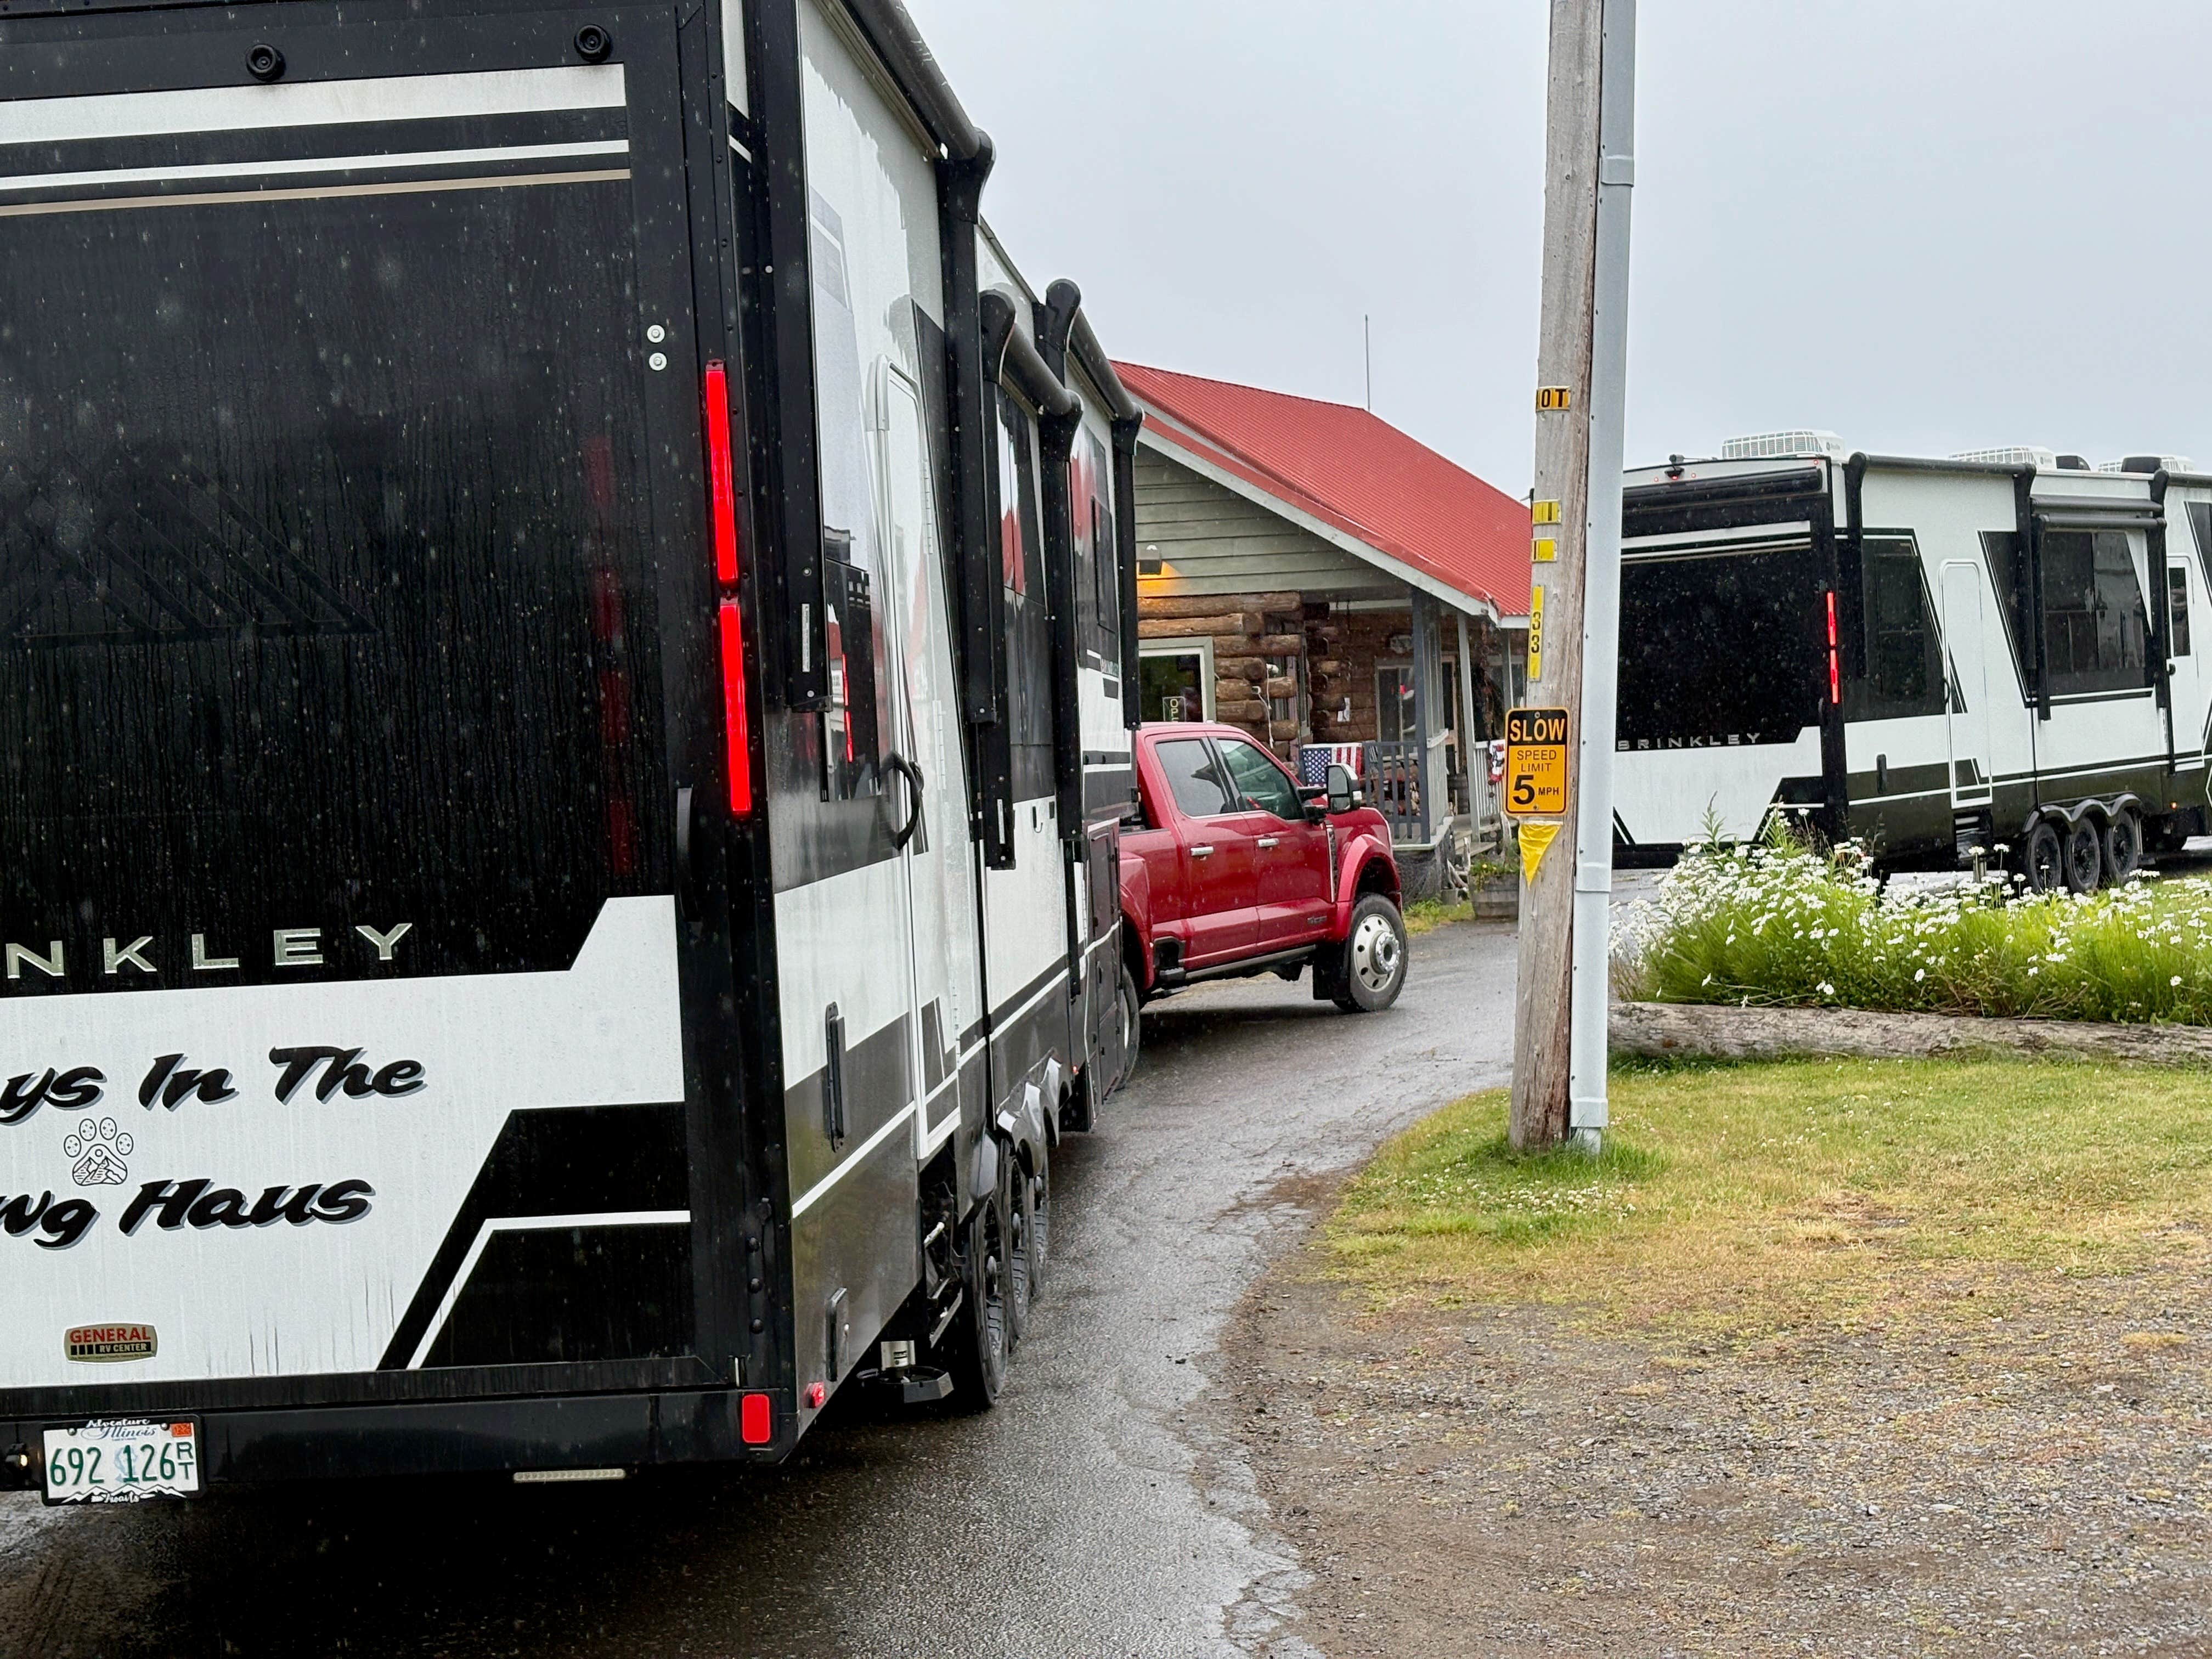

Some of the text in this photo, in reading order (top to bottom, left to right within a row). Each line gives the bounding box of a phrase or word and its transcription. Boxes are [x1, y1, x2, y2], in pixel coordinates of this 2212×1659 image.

[1536, 388, 1567, 408] OT
[1531, 611, 1541, 654] 33
[1510, 718, 1565, 742] SLOW
[1618, 732, 1760, 751] BRINKLEY
[1517, 749, 1557, 760] SPEED
[1521, 763, 1551, 772] LIMIT
[1513, 775, 1559, 805] 5 MPH
[5, 923, 414, 980] NKLEY
[139, 1053, 240, 1110] In
[269, 1046, 428, 1104] The
[119, 1178, 376, 1237] Haus
[70, 1327, 151, 1344] GENERAL
[99, 1343, 147, 1353] RV CENTER
[81, 1426, 157, 1441] Illinois
[50, 1447, 104, 1486] 692
[122, 1443, 176, 1482] 126
